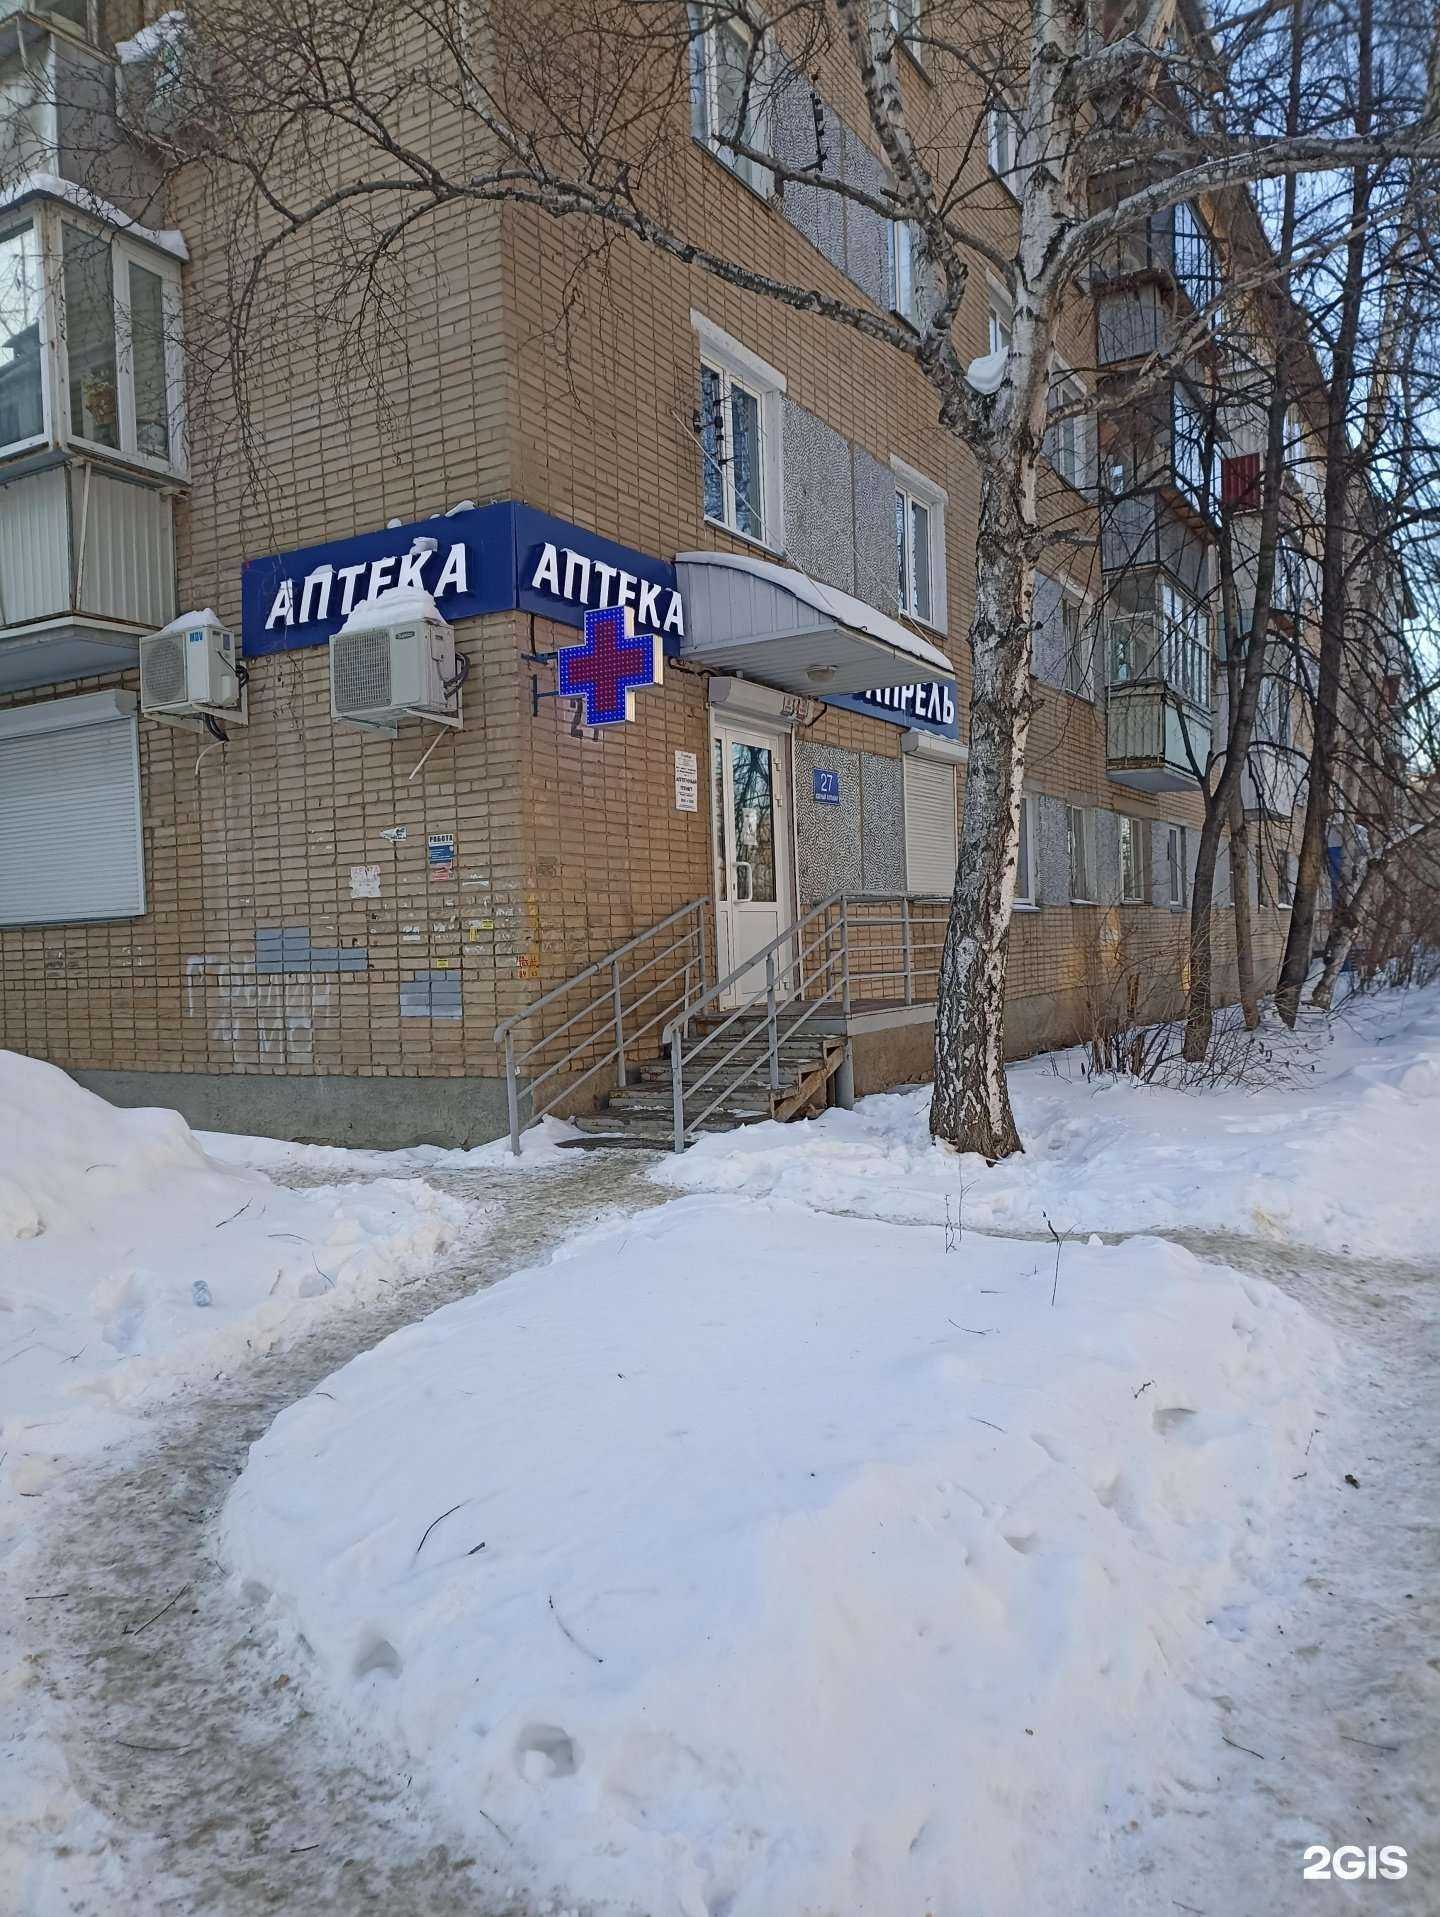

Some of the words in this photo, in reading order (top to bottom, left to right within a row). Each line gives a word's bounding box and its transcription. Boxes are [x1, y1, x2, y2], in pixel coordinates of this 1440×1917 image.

[265, 543, 468, 629] АПТЕКА
[531, 542, 685, 636] АПТЕКА
[821, 773, 833, 792] 27
